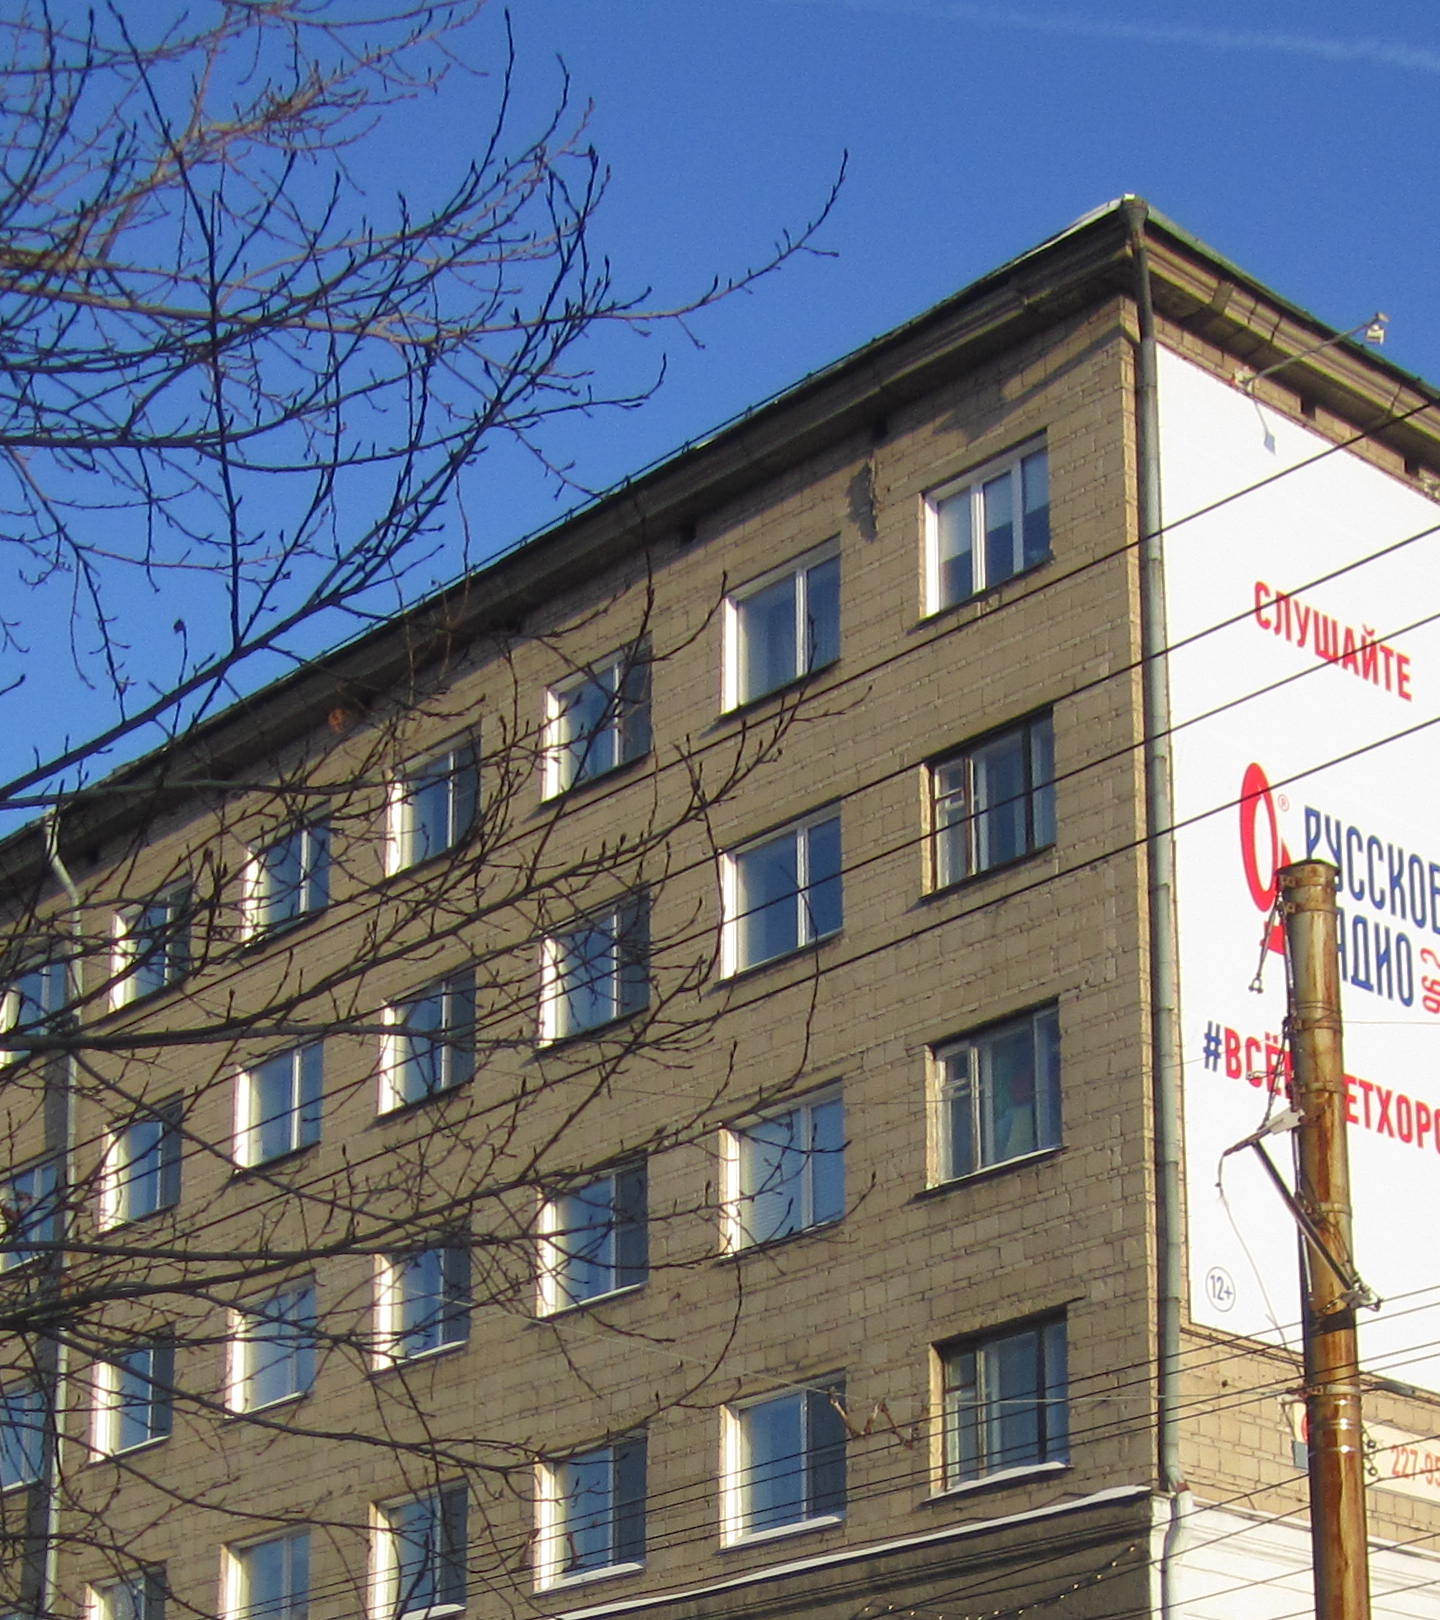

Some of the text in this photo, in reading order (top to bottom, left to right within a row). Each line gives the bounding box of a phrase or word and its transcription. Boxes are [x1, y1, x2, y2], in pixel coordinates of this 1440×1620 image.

[1254, 580, 1412, 702] СЛУШАЙТЕ
[1336, 905, 1415, 1008] АДИО
[1210, 1275, 1233, 1301] 12+
